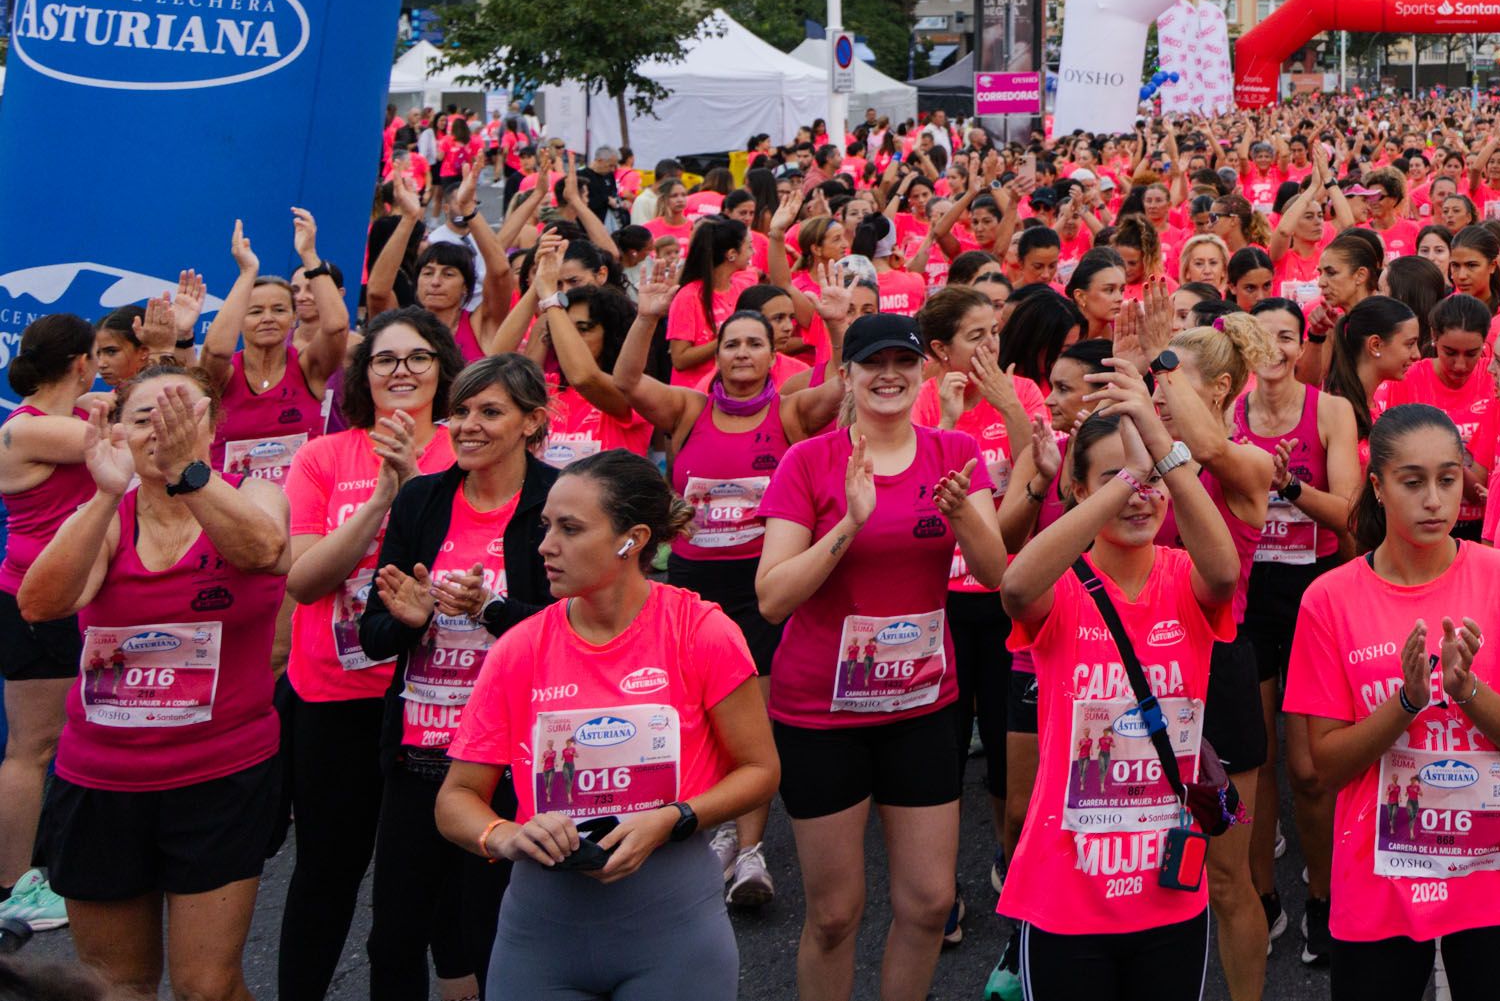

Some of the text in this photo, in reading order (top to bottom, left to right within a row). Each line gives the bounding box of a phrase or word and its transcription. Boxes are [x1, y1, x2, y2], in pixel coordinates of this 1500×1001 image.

[983, 6, 1020, 17] NEGA
[1395, 1, 1436, 17] Sports
[1064, 68, 1124, 87] OYSHO
[977, 90, 1039, 102] CORREDORAS
[252, 466, 283, 479] 016
[711, 507, 743, 520] 016
[880, 631, 918, 640] ASTURIANA
[126, 640, 177, 651] ASTURIANA
[432, 648, 476, 667] 016
[1349, 641, 1396, 665] OYSHO
[874, 660, 914, 679] 016
[125, 667, 175, 687] 016
[156, 711, 196, 721] Santander
[1084, 712, 1109, 720] SUMA
[547, 724, 572, 733] SUMA
[579, 727, 631, 741] ASTURIANA
[1112, 760, 1162, 782] 016
[1392, 760, 1416, 769] SUMA
[577, 766, 632, 792] 016
[1424, 769, 1475, 782] ASTURIANA
[1128, 786, 1146, 796] 867
[593, 793, 614, 805] 733
[1078, 796, 1162, 807] CARRERA DE LA MUJER A
[577, 807, 586, 816] DE
[587, 807, 597, 816] LA
[598, 804, 622, 815] MUJER
[627, 803, 633, 812] A
[1079, 813, 1122, 825] OYSHO
[1421, 808, 1472, 832] 016
[1388, 842, 1418, 852] CARRERA
[1419, 845, 1428, 853] DE
[1429, 846, 1438, 854] LA
[1439, 846, 1462, 855] MUJER
[1467, 847, 1473, 855] A
[1390, 857, 1495, 872] OYSHO Santander
[1105, 876, 1143, 899] 2026
[1411, 880, 1448, 903] 2026
